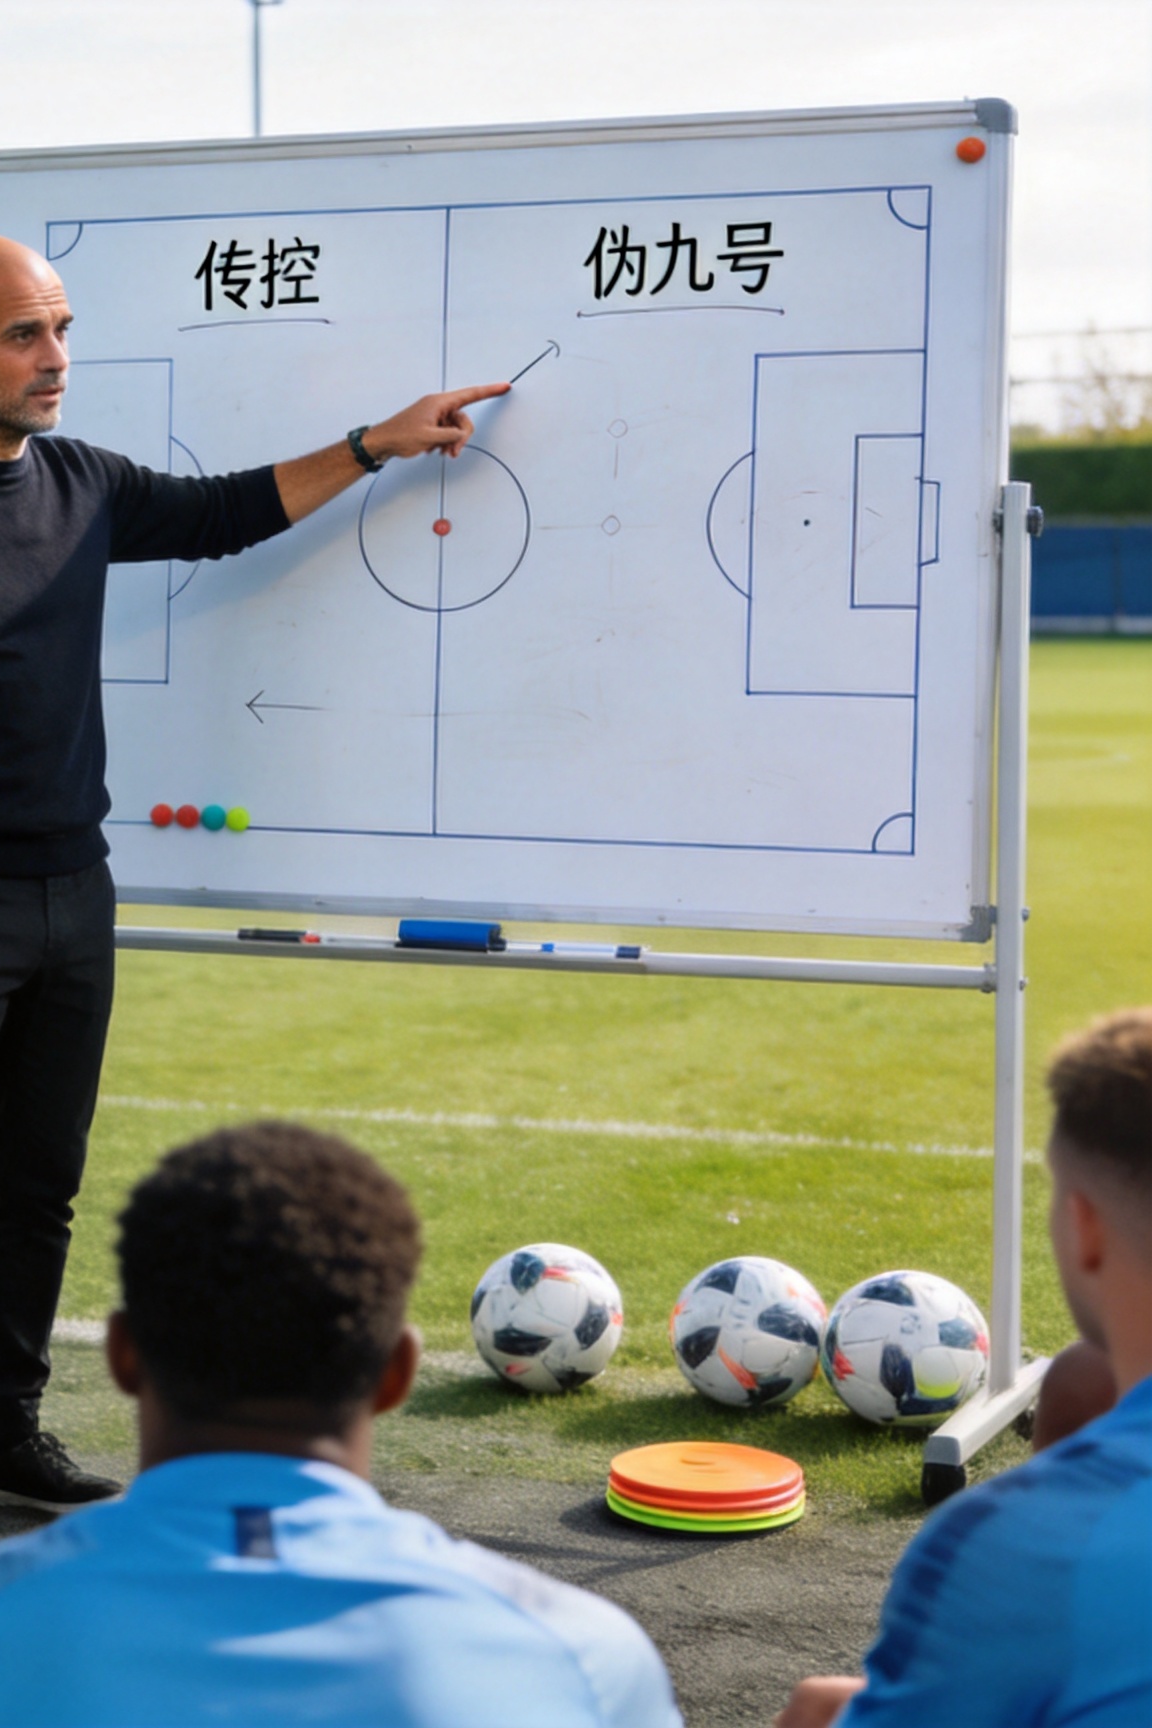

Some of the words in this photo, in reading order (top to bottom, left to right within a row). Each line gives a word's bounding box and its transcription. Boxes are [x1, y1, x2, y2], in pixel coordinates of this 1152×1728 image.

[194, 236, 320, 310] 传控
[583, 221, 785, 299] 伪九号
